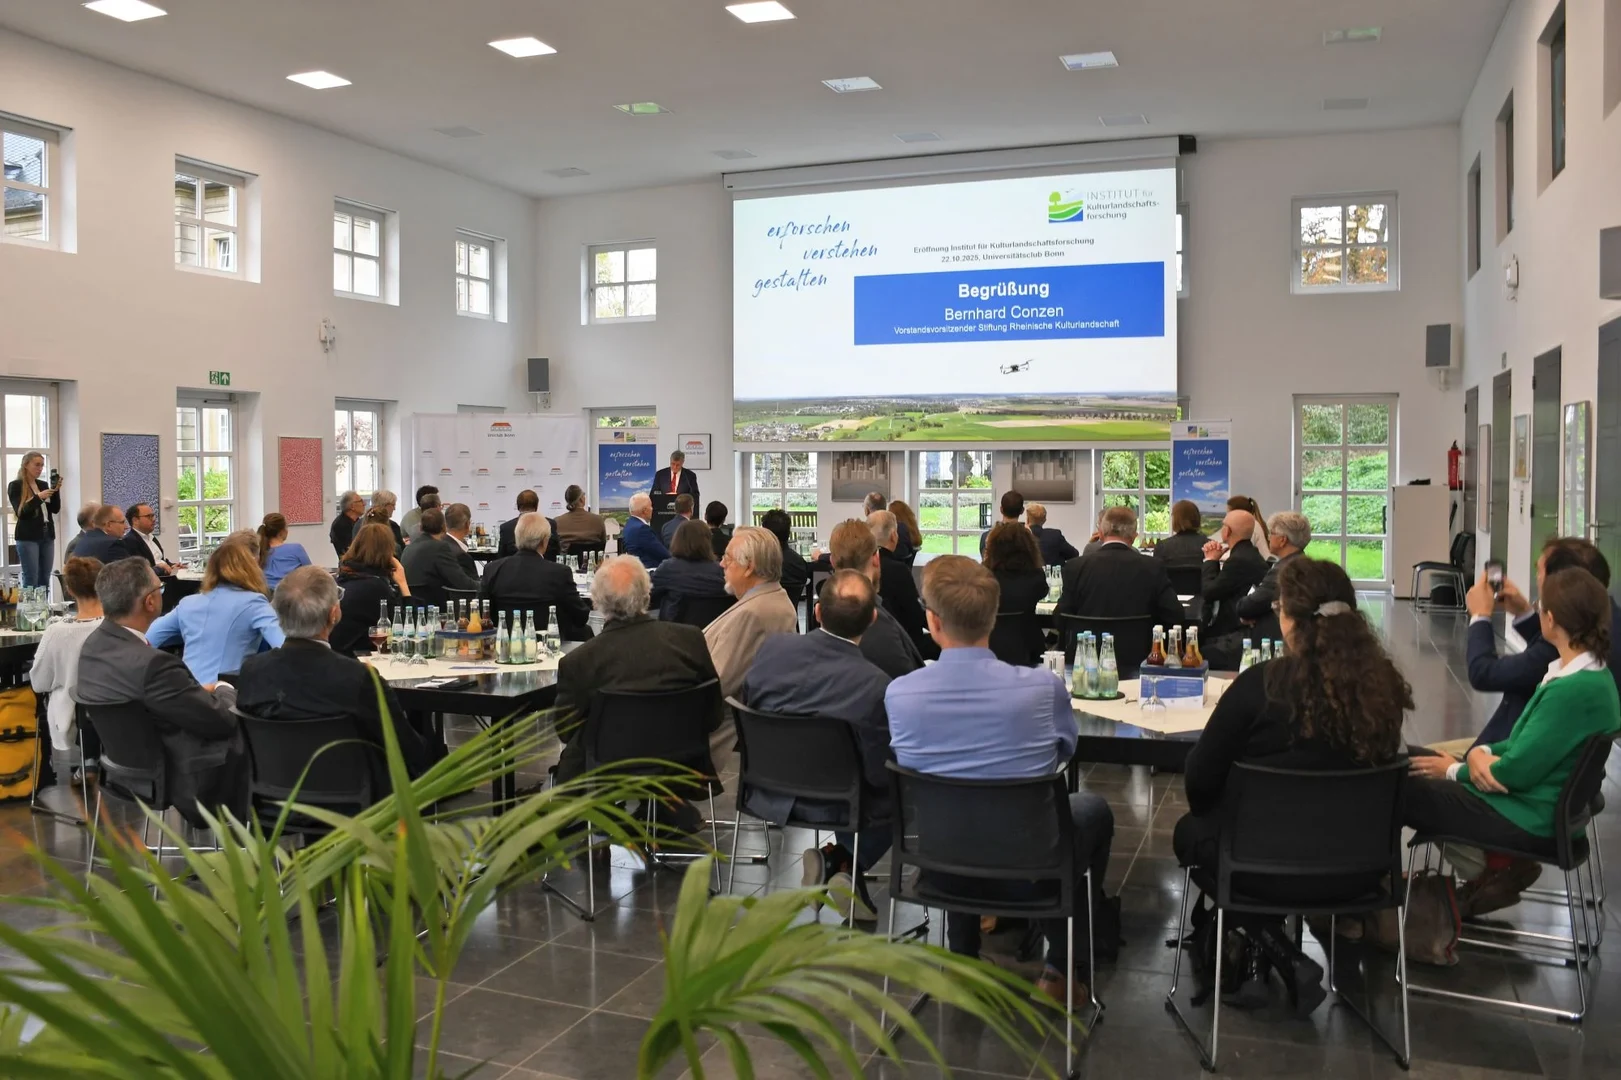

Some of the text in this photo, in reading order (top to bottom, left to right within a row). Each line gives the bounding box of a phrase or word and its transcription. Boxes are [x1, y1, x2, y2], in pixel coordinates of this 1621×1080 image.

[1086, 189, 1154, 200] INSTITUT für
[1086, 200, 1160, 211] Kulturlandschafts-
[1086, 211, 1127, 220] forschung
[767, 215, 851, 250] erforschen
[803, 238, 878, 260] verstehen
[913, 238, 1095, 254] Eröffnung Institut für Kulturlandschaftsforschung
[941, 250, 1065, 263] 22.10.2025, Universitätsclub Bonn
[751, 268, 827, 298] gestalten
[958, 281, 1050, 301] Begrüßung
[944, 304, 1064, 321] Bernhard Conzen
[893, 319, 1120, 335] Vorstandsvorsitzender Stiftung Rheinische Kulturlandschaft
